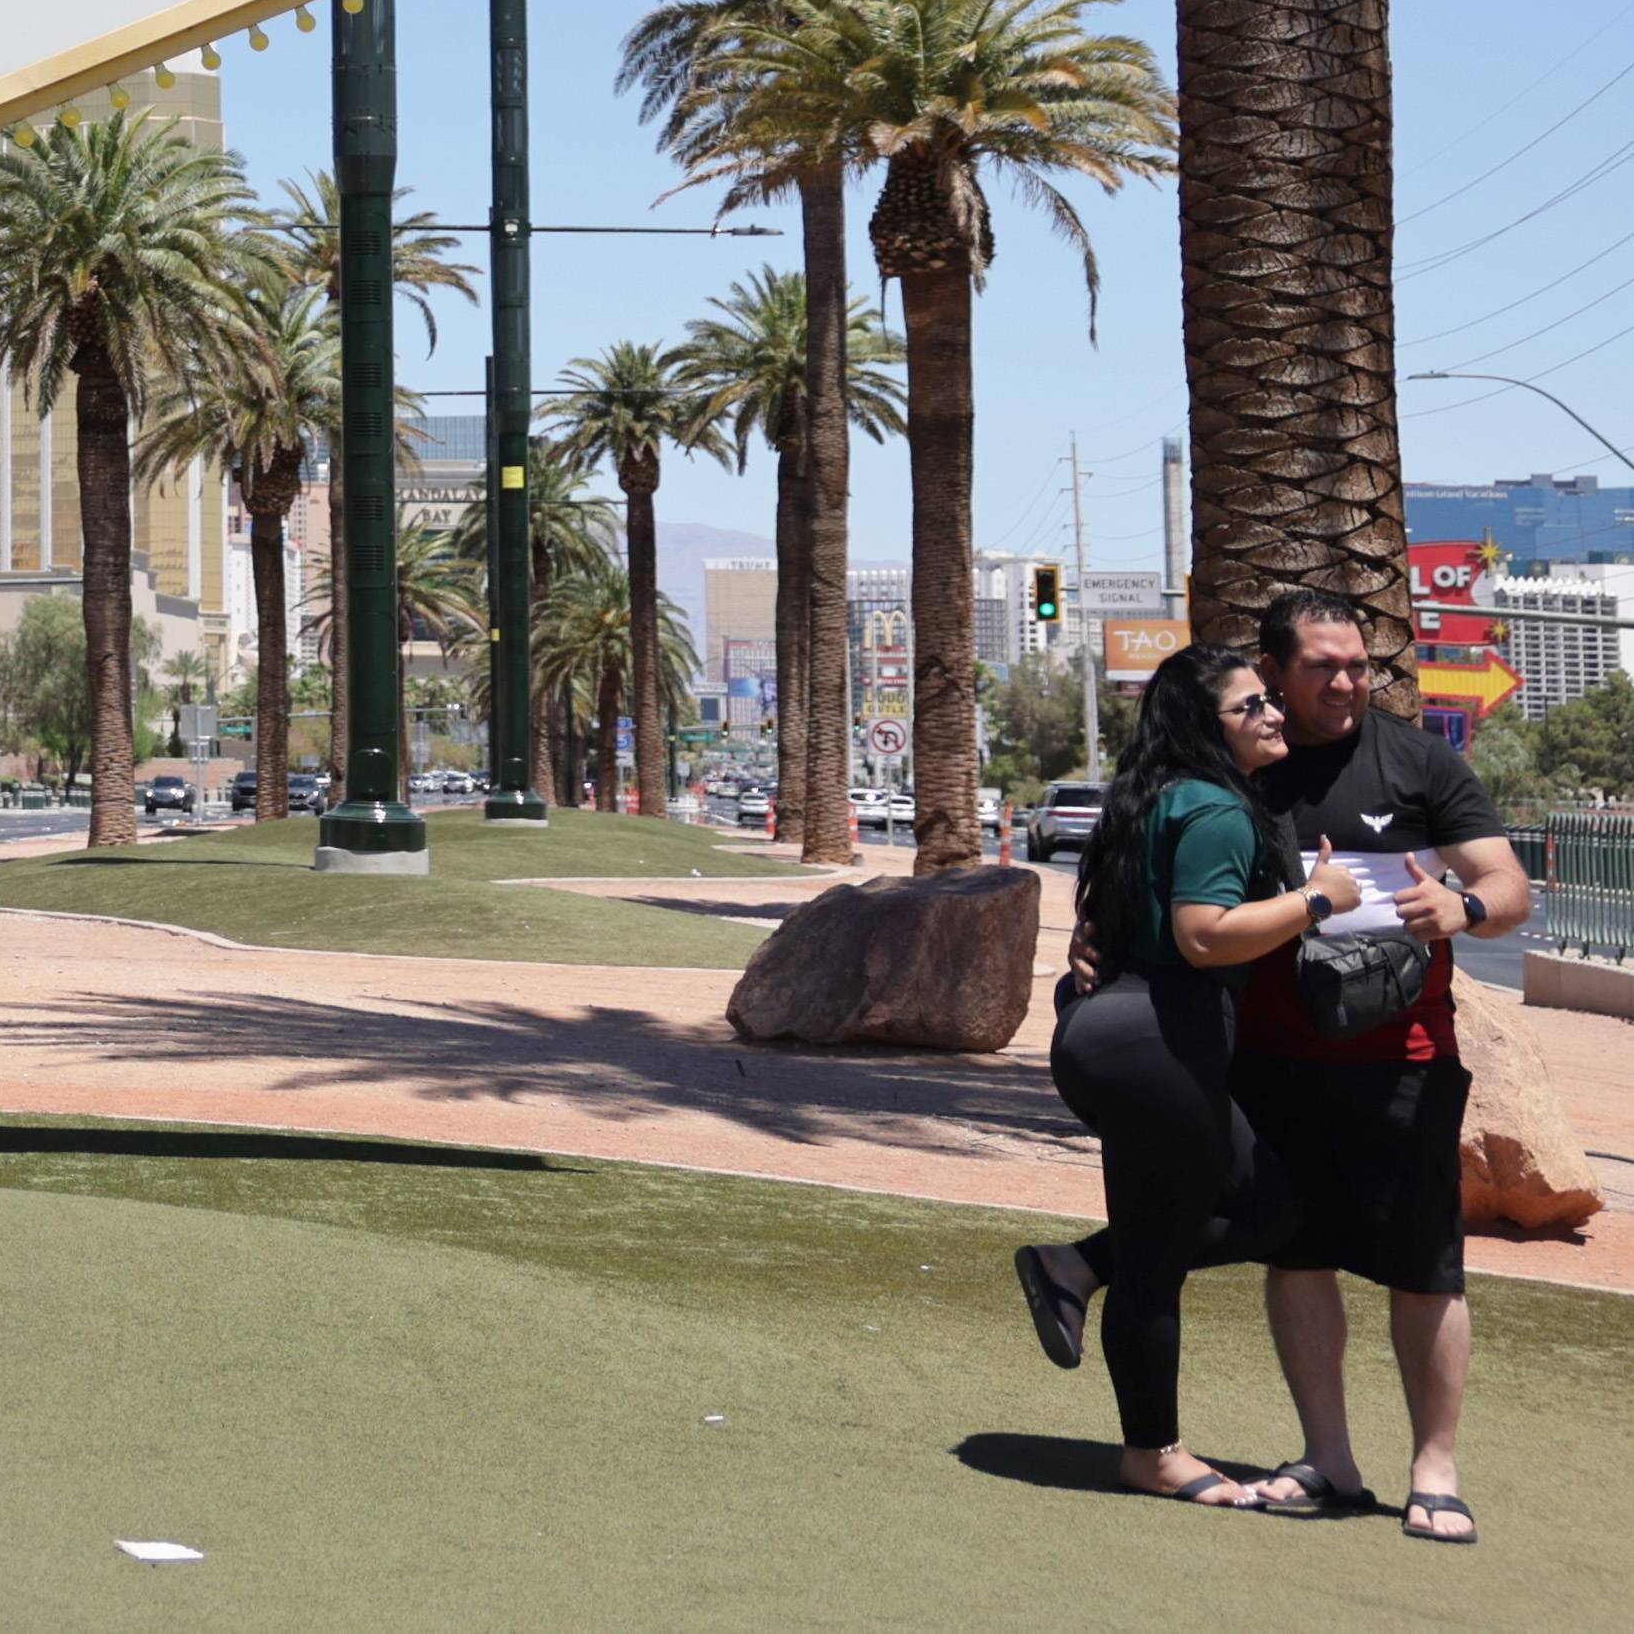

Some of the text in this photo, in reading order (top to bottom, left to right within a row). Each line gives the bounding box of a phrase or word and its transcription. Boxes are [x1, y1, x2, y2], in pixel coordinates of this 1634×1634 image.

[1083, 578, 1156, 590] EMERGENCY
[1433, 565, 1472, 588] OF
[1099, 592, 1144, 604] SIGNAL
[1113, 629, 1177, 652] TAO
